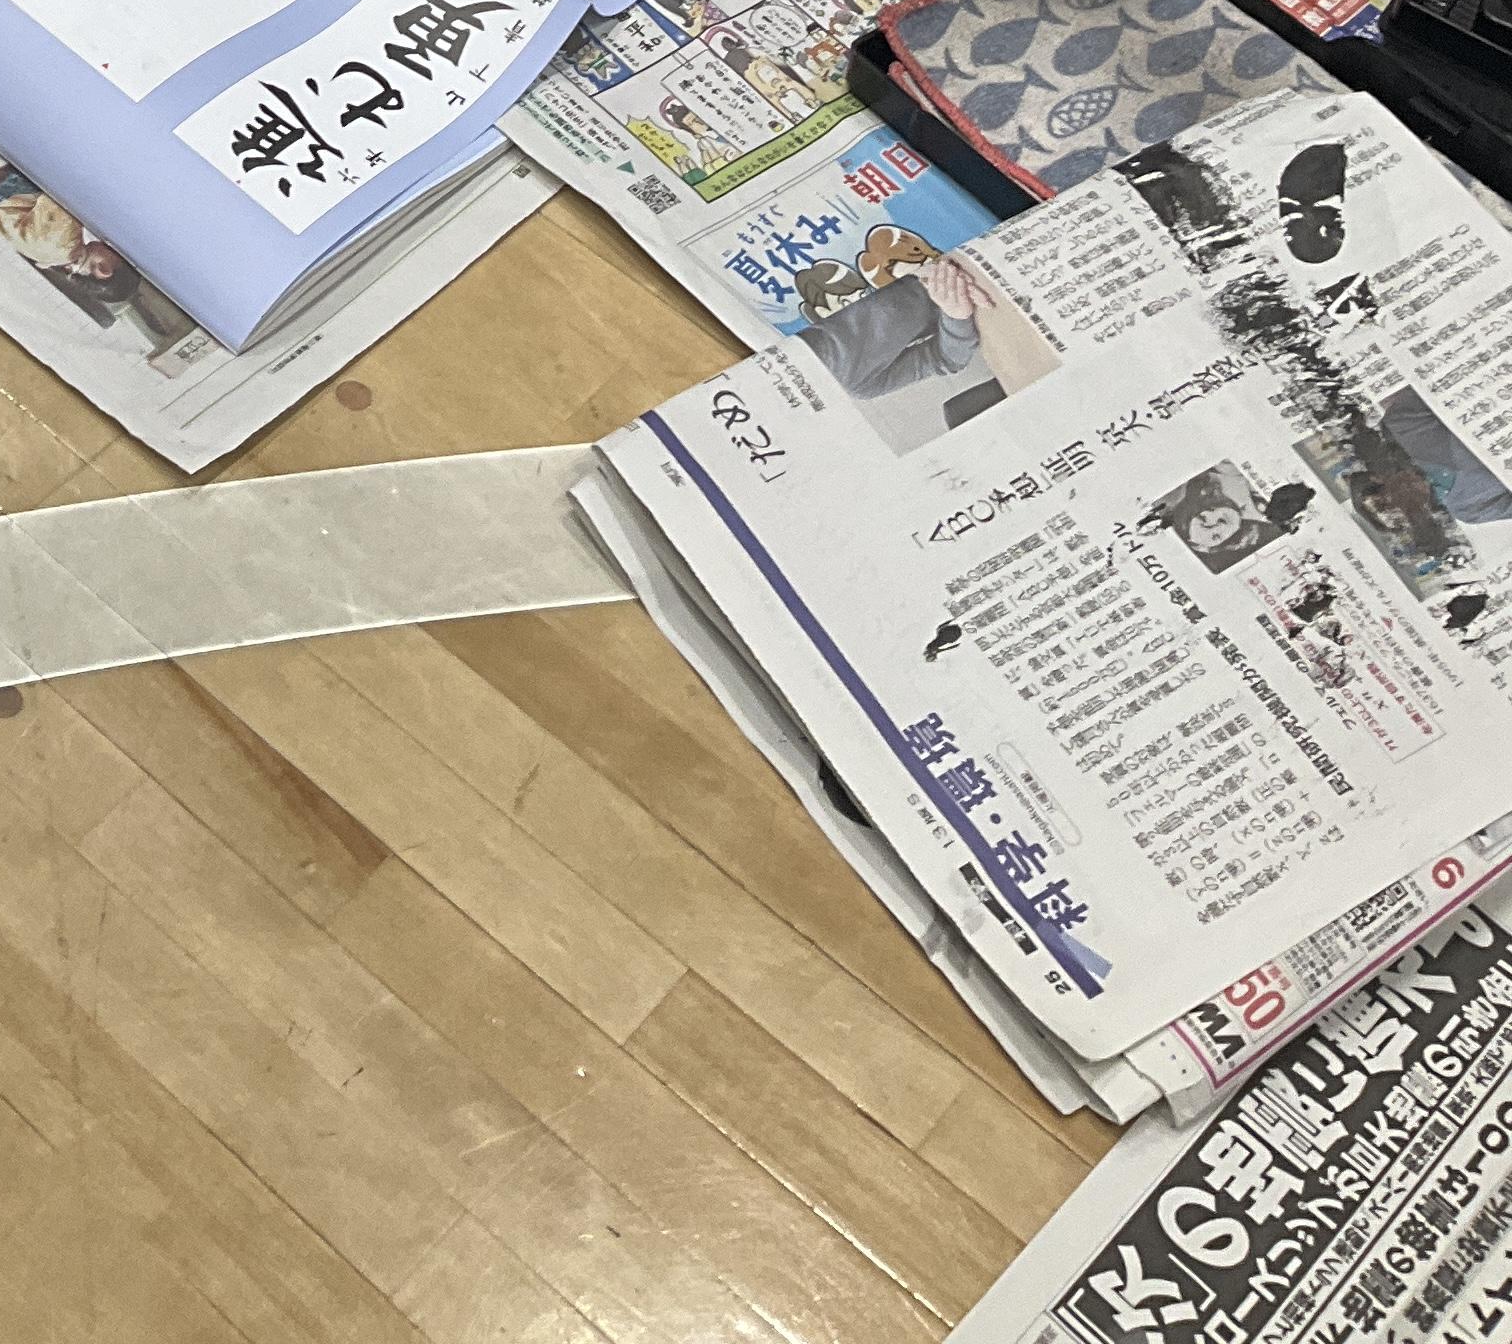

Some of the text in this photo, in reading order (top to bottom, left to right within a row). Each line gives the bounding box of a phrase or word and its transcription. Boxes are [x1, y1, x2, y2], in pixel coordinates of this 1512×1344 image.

[843, 133, 933, 204] 朝日
[724, 214, 845, 306] 夏休み
[736, 203, 784, 245] もうすぐ
[910, 440, 1096, 549] 「ABC予想」証明
[1112, 521, 1208, 627] 賞金10万ドル
[1204, 627, 1355, 796] 民間研究機関が発表
[900, 708, 1087, 937] 科学・環境
[984, 753, 1056, 844] kagaku@asahi.com
[1432, 857, 1465, 889] 6
[1044, 970, 1073, 995] 25
